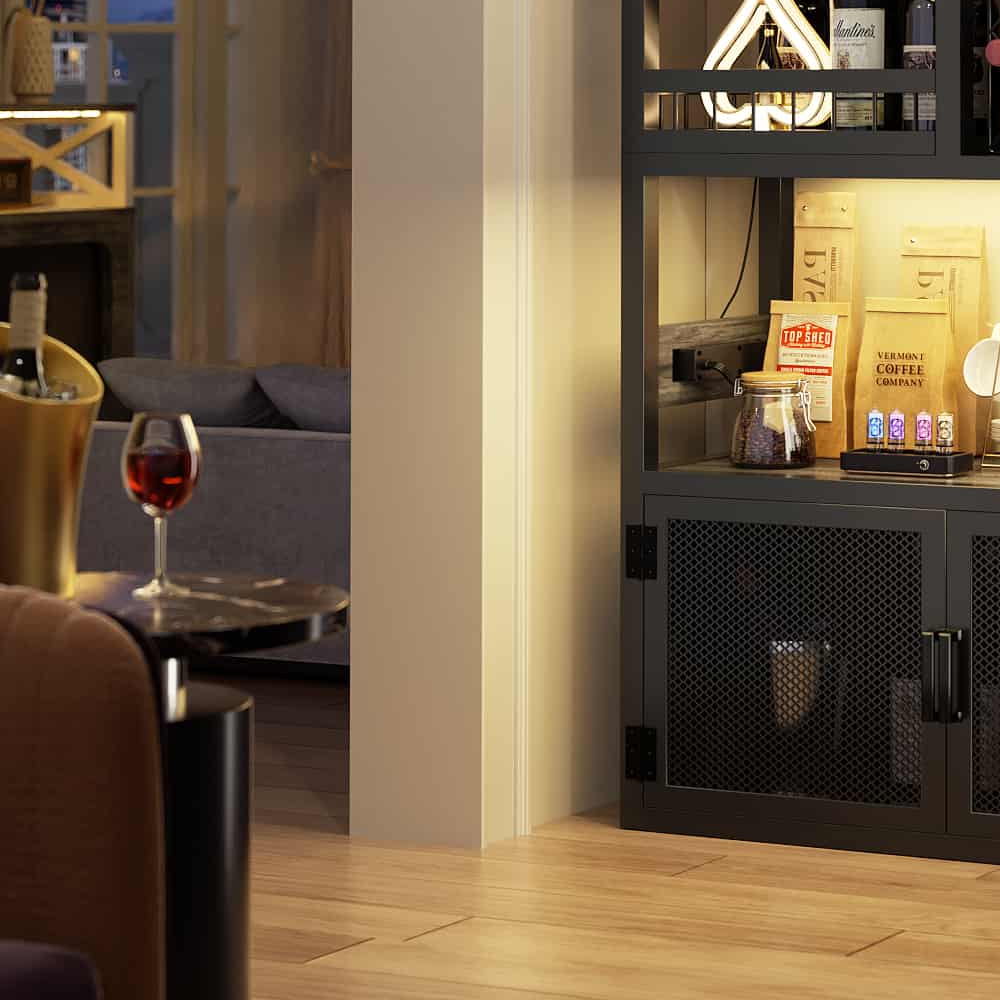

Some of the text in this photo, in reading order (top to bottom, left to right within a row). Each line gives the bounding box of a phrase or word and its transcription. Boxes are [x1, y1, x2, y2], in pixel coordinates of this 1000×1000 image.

[877, 351, 925, 360] VERMONT
[876, 363, 925, 375] COFFEE
[876, 377, 925, 387] COMPANY
